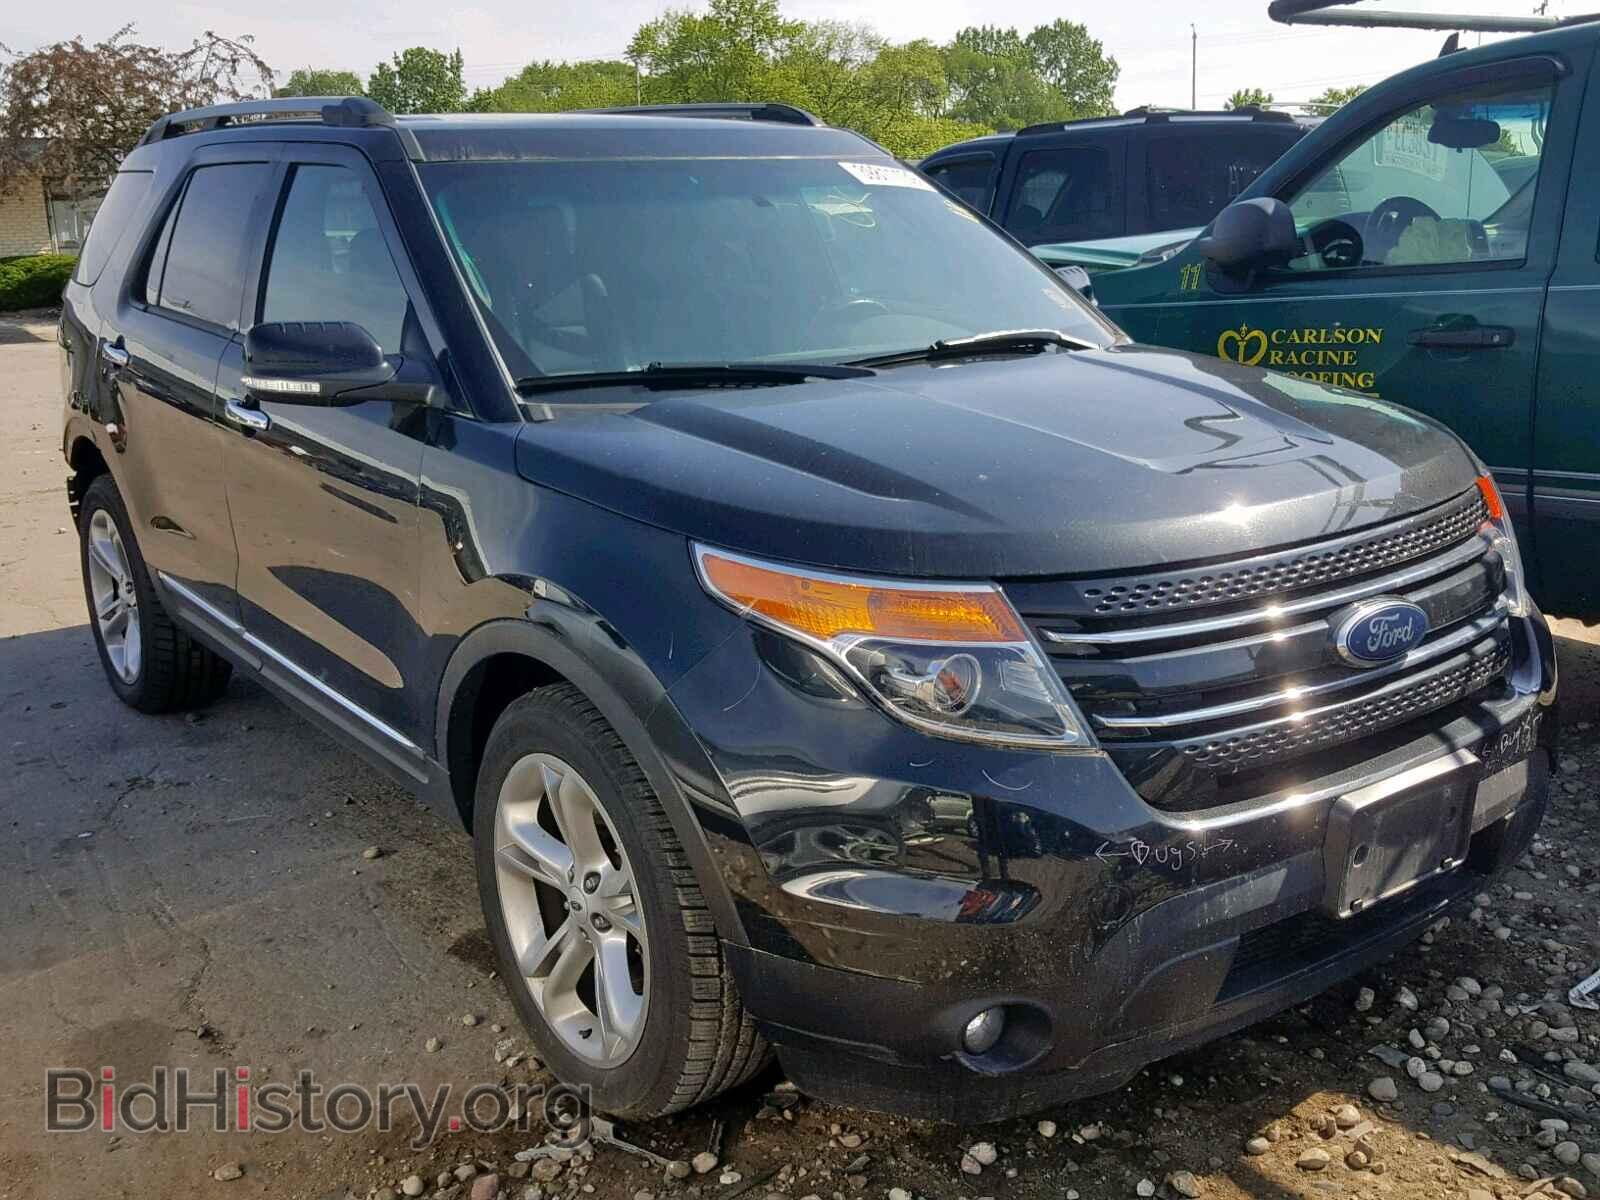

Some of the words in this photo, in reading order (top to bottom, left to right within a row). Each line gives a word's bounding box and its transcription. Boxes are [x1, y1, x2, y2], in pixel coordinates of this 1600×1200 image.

[1180, 263, 1202, 290] 11
[1271, 327, 1384, 344] CARLSON
[1268, 350, 1358, 366] RACINE
[1367, 612, 1414, 652] Ford
